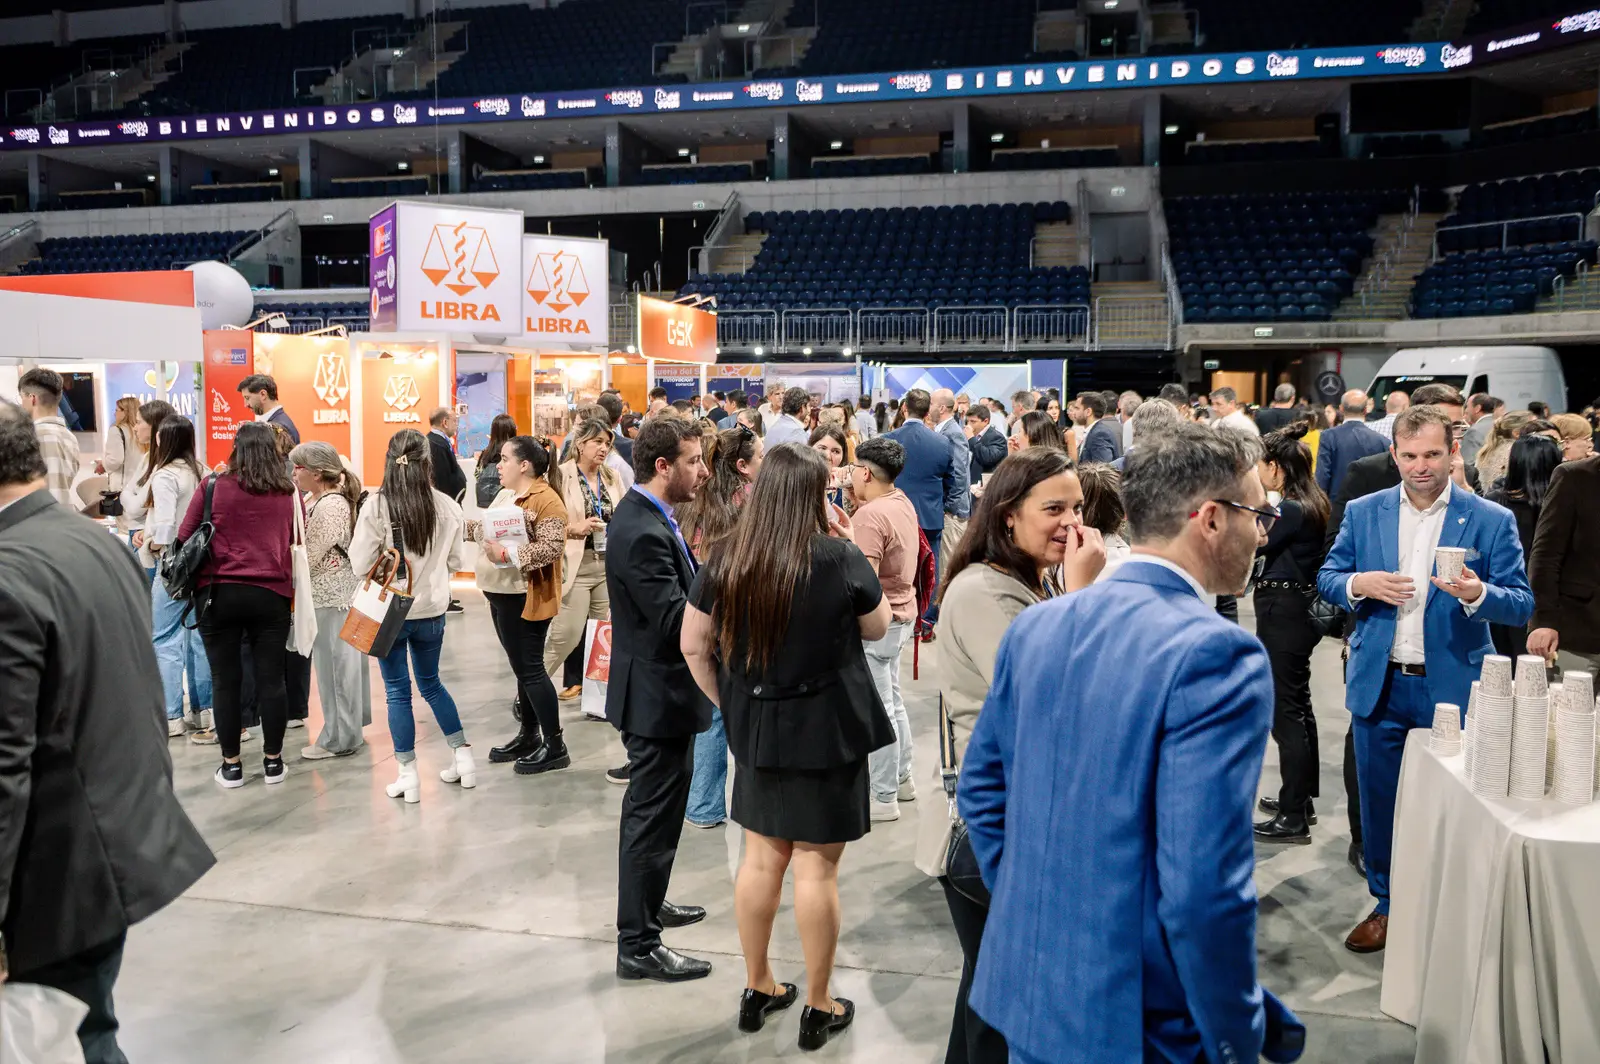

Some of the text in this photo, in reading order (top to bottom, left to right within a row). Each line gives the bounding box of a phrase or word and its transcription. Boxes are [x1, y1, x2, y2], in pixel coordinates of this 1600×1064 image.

[1384, 47, 1426, 62] RONDA
[897, 73, 932, 88] RONDA
[946, 57, 1255, 90] BIENVENIDOS
[612, 90, 643, 104] RONDA
[750, 82, 783, 97] RONDA
[480, 98, 509, 112] RONDA
[159, 107, 385, 135] BIENVENIDOS
[420, 300, 501, 322] LIBRA
[526, 316, 591, 334] LIBRA
[668, 318, 694, 348] GSK
[680, 367, 693, 375] del
[313, 409, 350, 424] LIBRA
[383, 411, 421, 423] LIBRA
